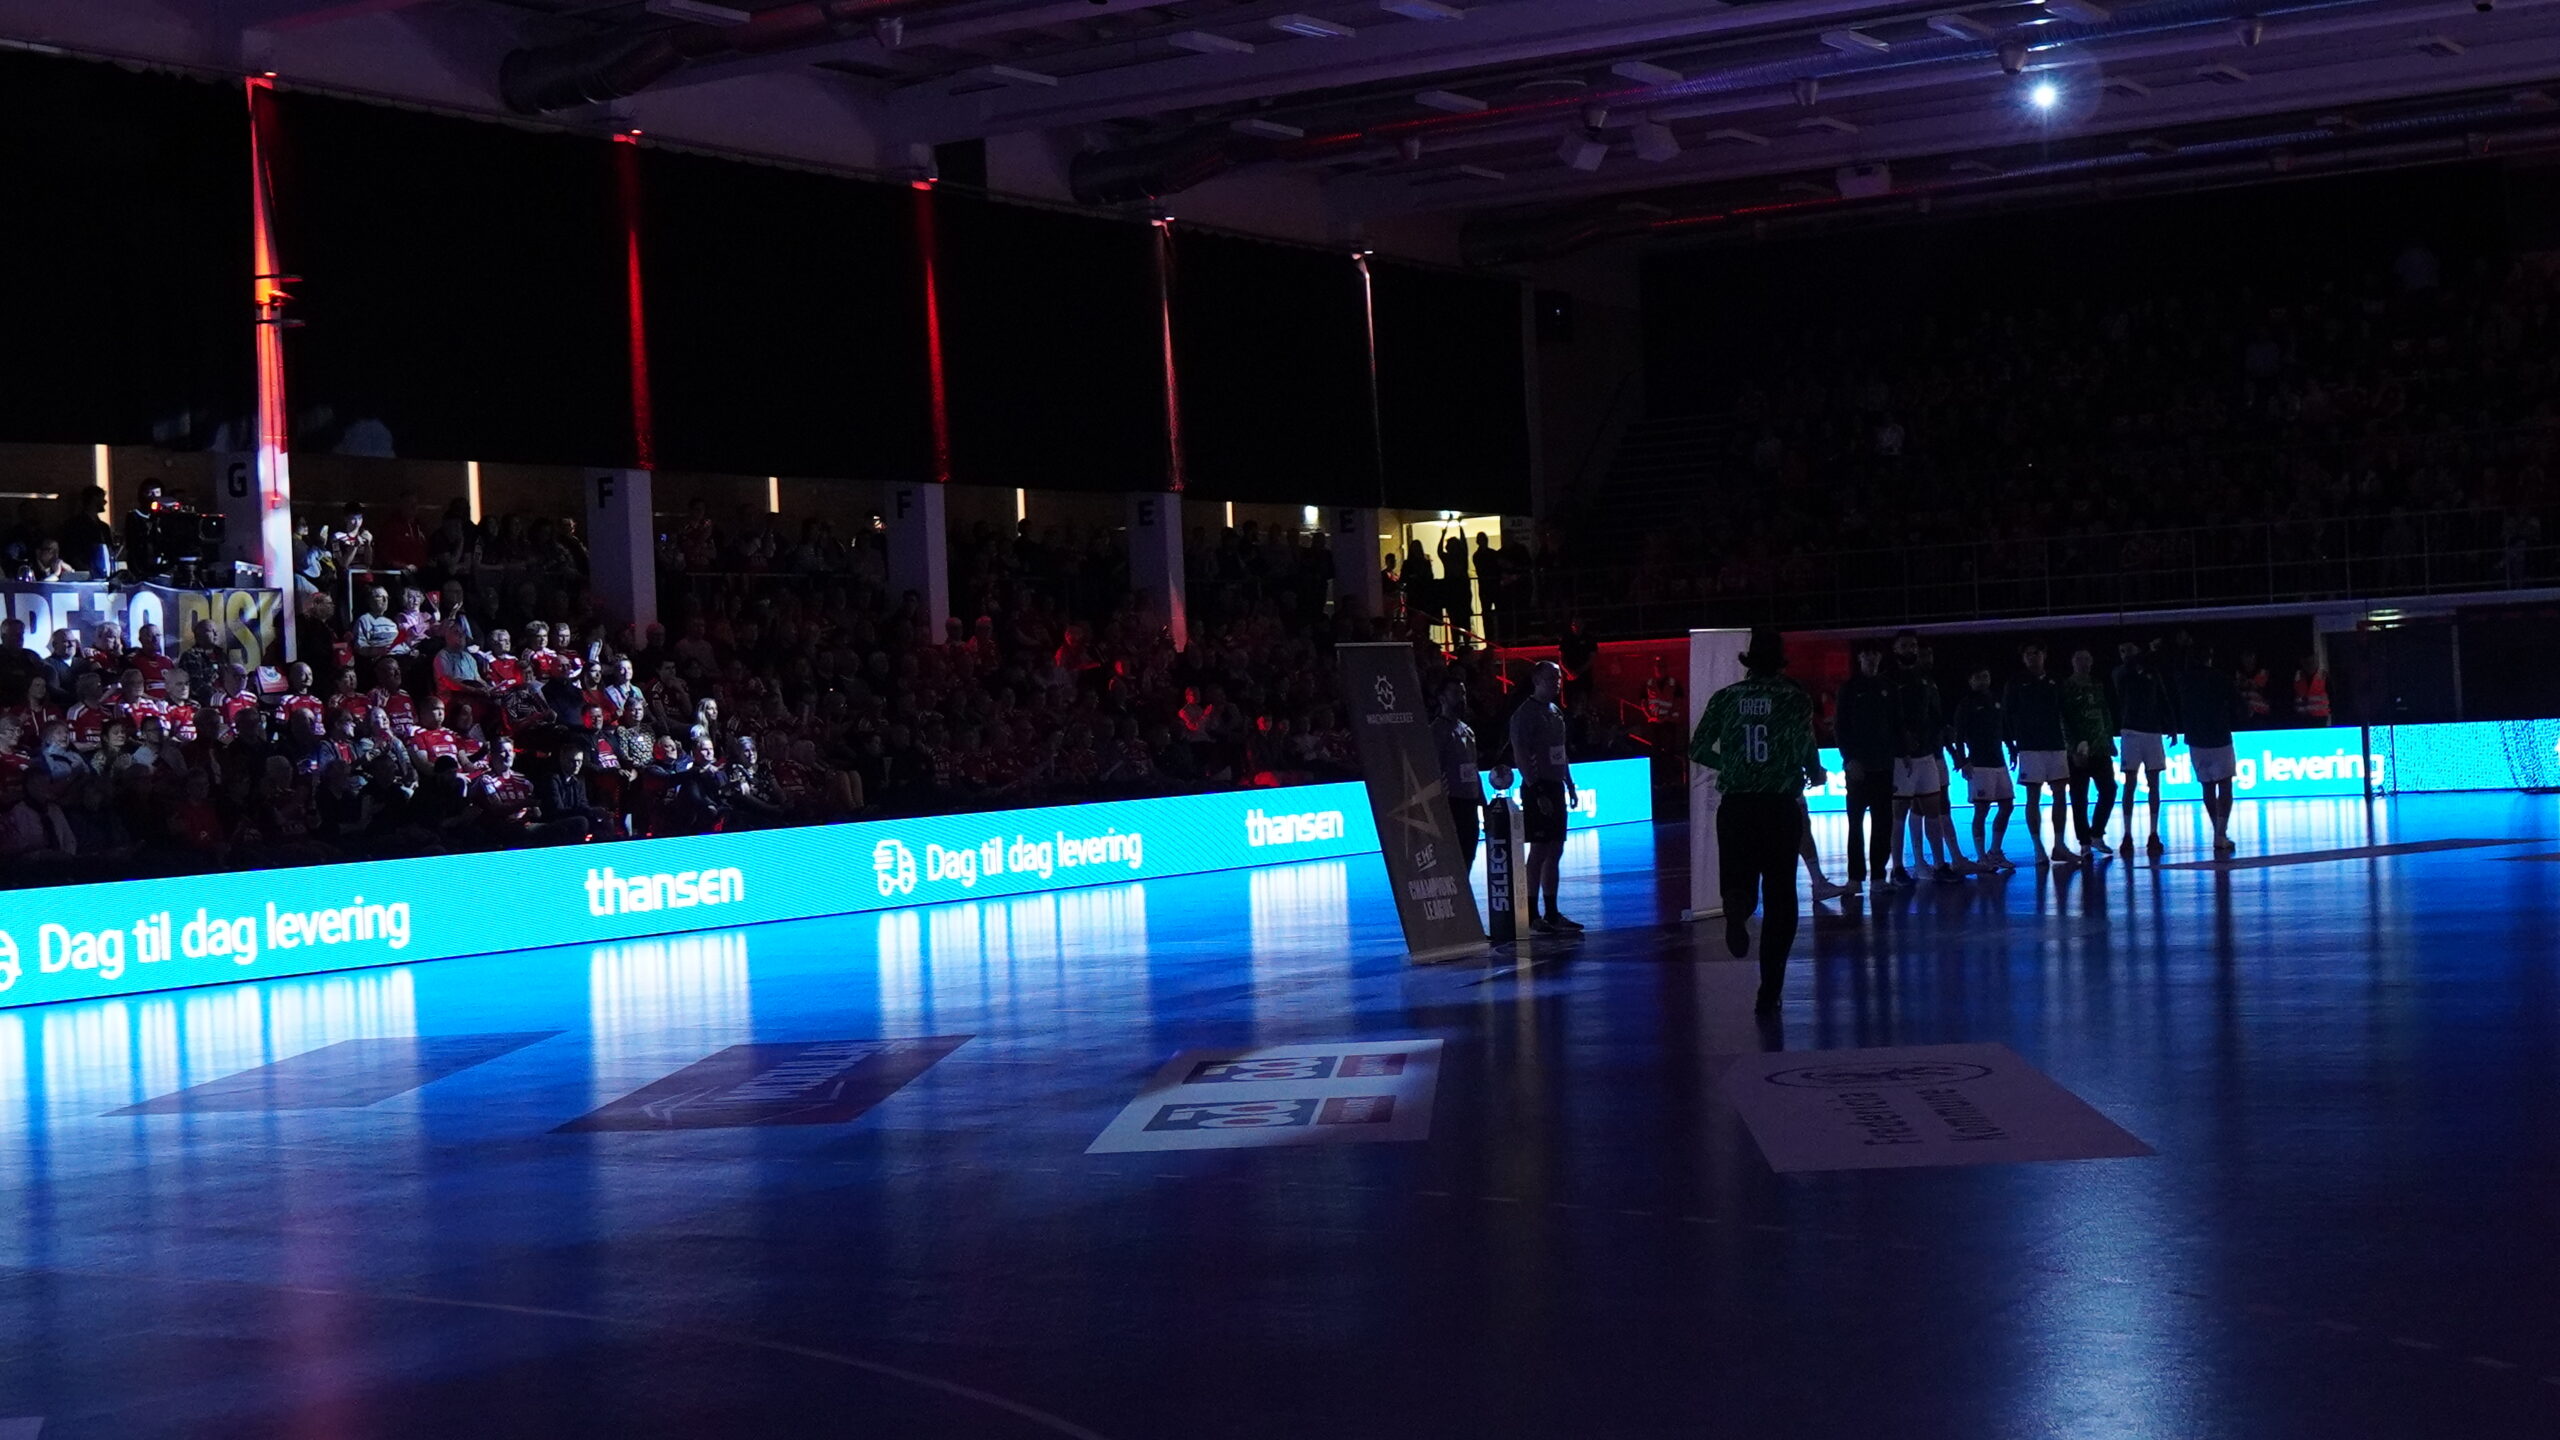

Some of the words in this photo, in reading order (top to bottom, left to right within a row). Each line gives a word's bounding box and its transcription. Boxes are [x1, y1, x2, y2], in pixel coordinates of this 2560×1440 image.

[228, 462, 247, 497] G
[598, 477, 613, 508] F
[897, 490, 911, 519] F
[1138, 500, 1154, 526] E
[1738, 697, 1772, 716] GREEN
[1741, 723, 1769, 763] 16
[1245, 808, 1344, 848] thansen
[926, 844, 977, 888] Dag
[981, 836, 1004, 877] til
[1008, 834, 1053, 880] dag
[1057, 827, 1143, 869] levering
[1415, 843, 1436, 868] EHF
[584, 866, 745, 916] thansen
[1408, 875, 1458, 900] CHAMPIONS
[1489, 838, 1511, 912] SELECT
[1423, 898, 1456, 921] LEAGUE
[38, 922, 126, 981] Dag
[131, 910, 172, 964] til
[180, 907, 259, 966] dag
[265, 895, 412, 949] levering
